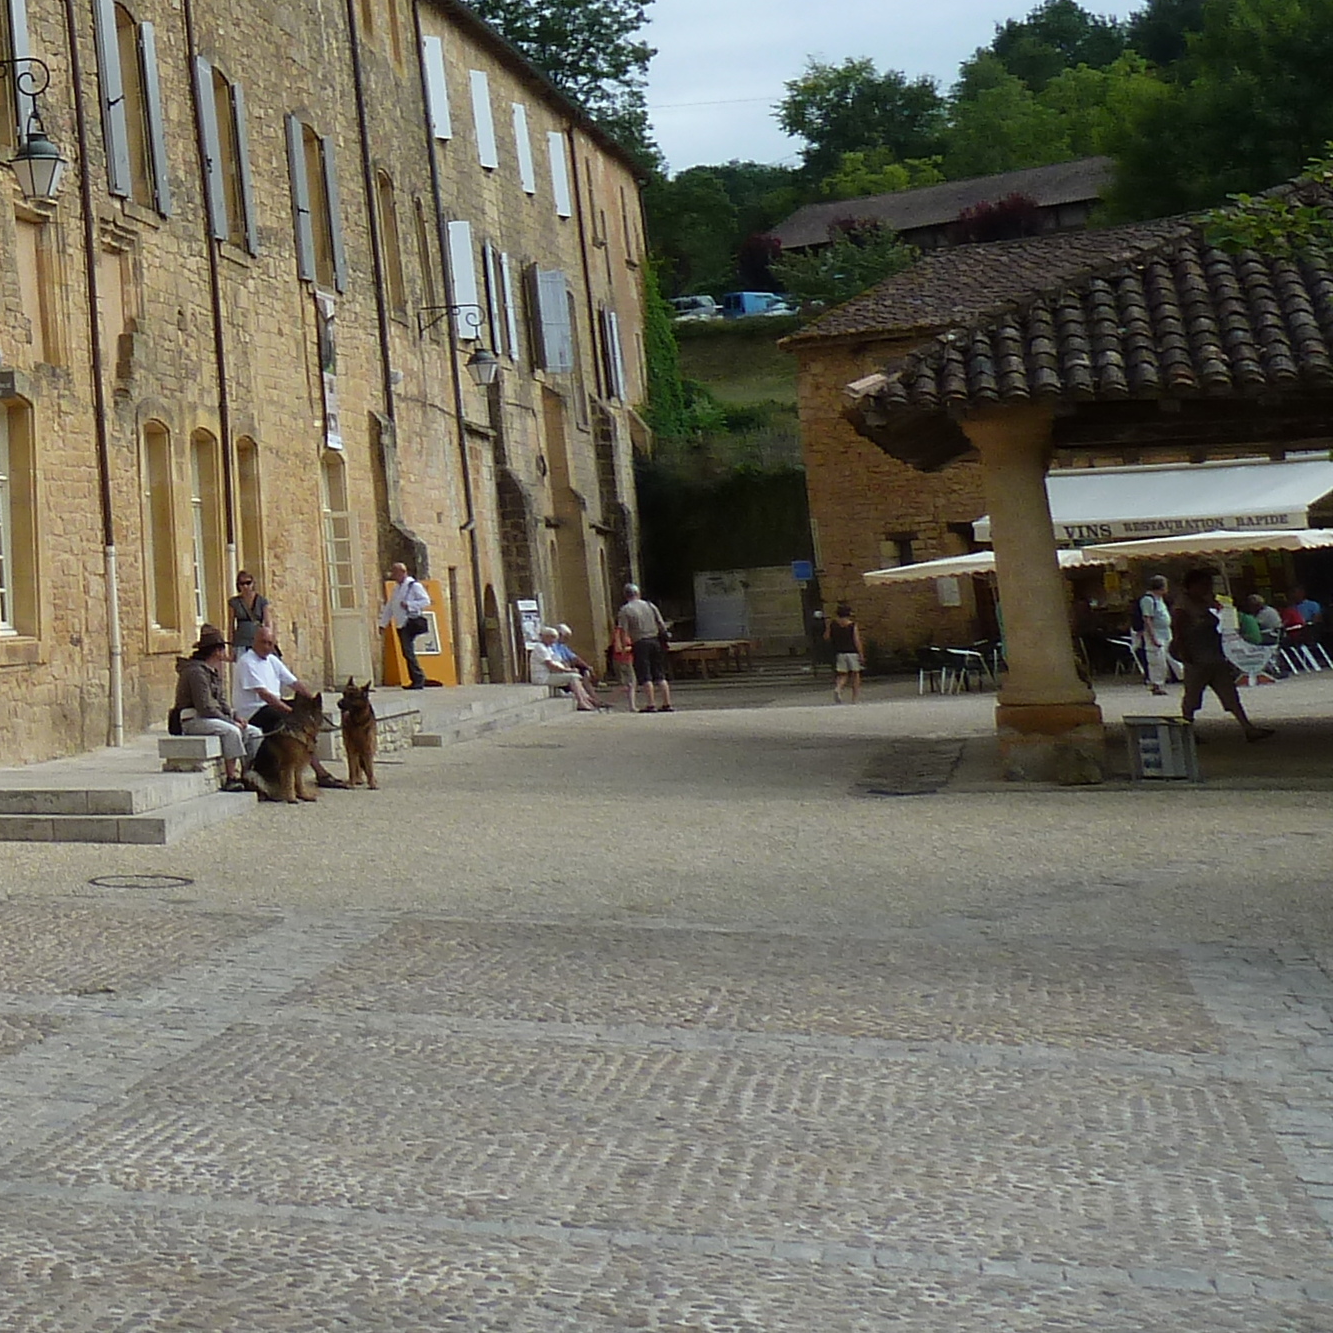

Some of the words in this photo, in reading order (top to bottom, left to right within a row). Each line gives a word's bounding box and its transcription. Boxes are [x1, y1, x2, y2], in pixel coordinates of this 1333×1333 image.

[1063, 523, 1112, 539] VINS
[1123, 516, 1225, 532] RESTAURATION
[1236, 513, 1290, 527] RAPIDE
